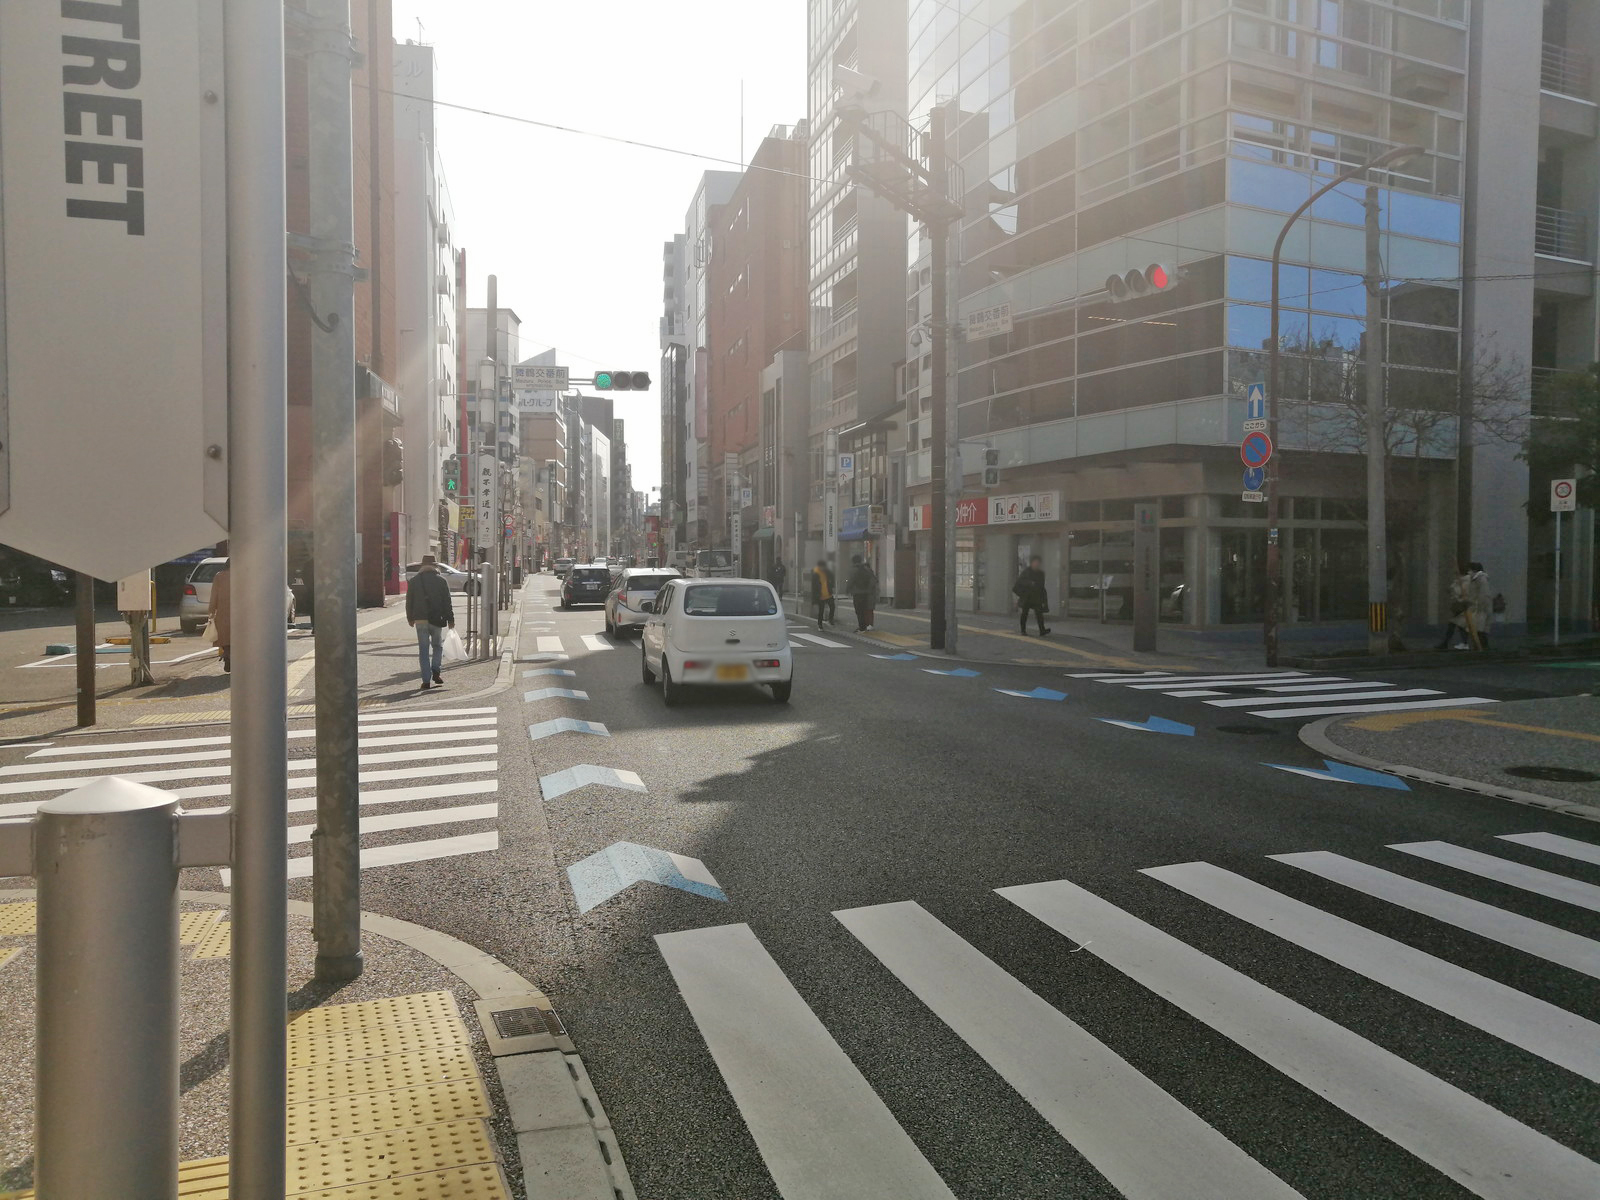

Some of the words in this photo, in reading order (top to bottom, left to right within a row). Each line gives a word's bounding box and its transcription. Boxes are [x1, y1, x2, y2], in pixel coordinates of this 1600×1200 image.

[515, 368, 565, 379] 舞鶴交番前
[1244, 421, 1265, 430] ここから
[481, 467, 492, 520] 親不孝通り
